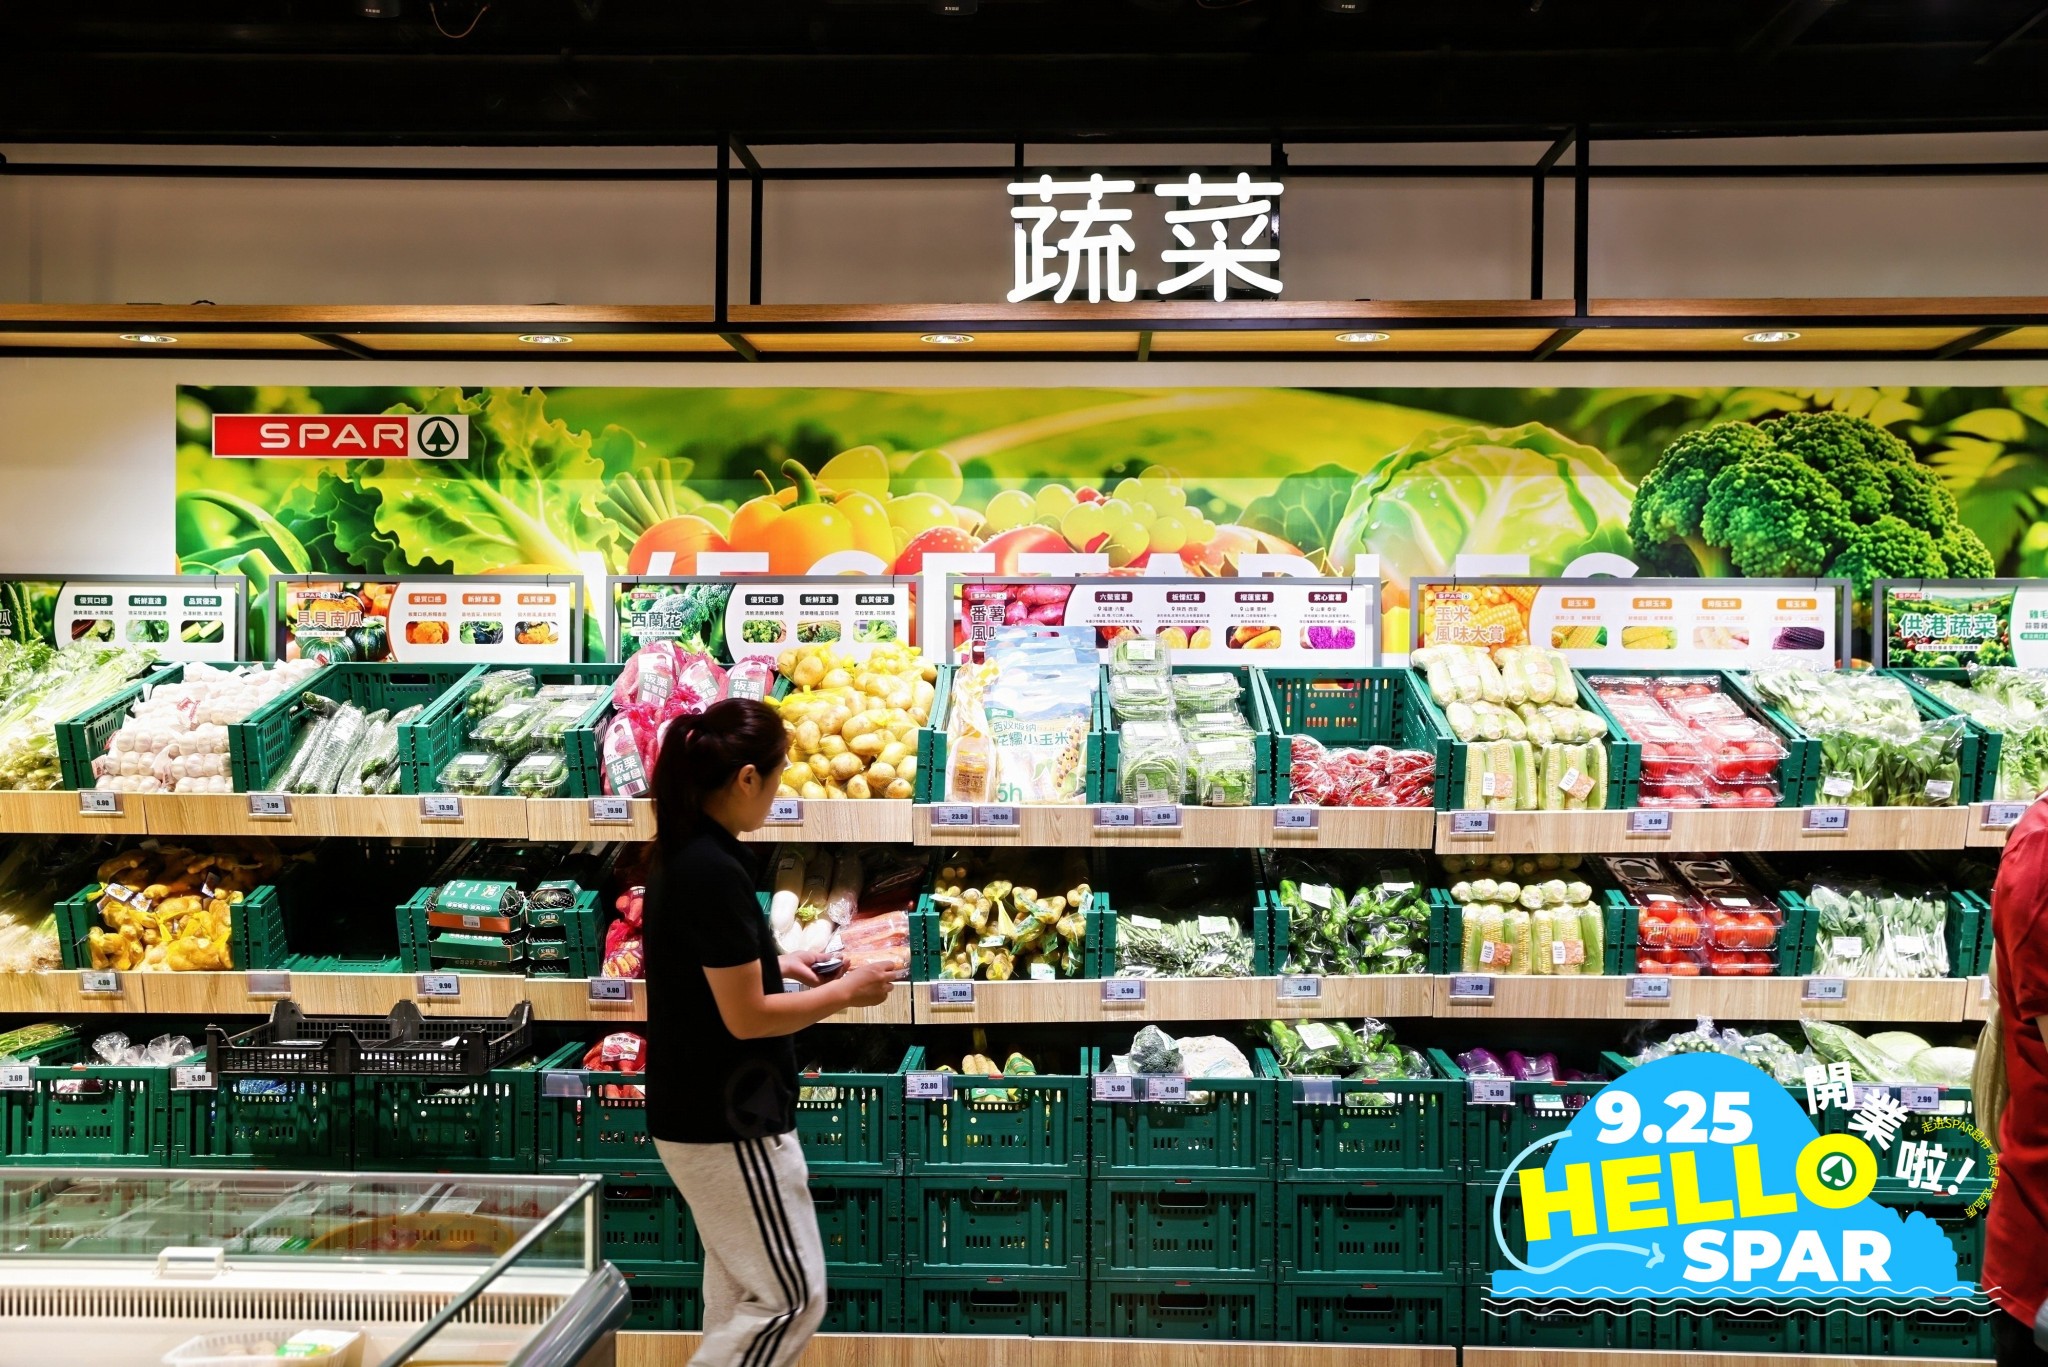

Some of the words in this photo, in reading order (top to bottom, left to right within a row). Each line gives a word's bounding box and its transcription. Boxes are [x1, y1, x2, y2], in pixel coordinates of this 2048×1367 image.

[1006, 172, 1285, 304] 蔬菜
[260, 422, 404, 449] SPAR
[80, 596, 108, 605] 優質口感
[133, 597, 162, 605] 新鮮直達
[188, 597, 217, 605] 品質優選
[750, 596, 779, 604] 優質口感
[805, 596, 833, 604] 新鮮直達
[860, 596, 889, 604] 品質優選
[297, 611, 363, 627] 貝貝南瓜
[631, 612, 683, 628] 西蘭花
[971, 605, 1005, 622] 番薯
[1436, 606, 1470, 622] 玉米
[1900, 614, 1997, 637] 供港蔬菜
[1435, 626, 1505, 642] 風味大賞
[643, 673, 669, 689] 板栗
[733, 680, 760, 693] 板栗
[611, 757, 637, 777] 板栗
[191, 1074, 206, 1082] 5.90
[920, 1082, 938, 1090] 23.80
[1164, 1086, 1179, 1094] 4.90
[1490, 1089, 1504, 1097] 5.90
